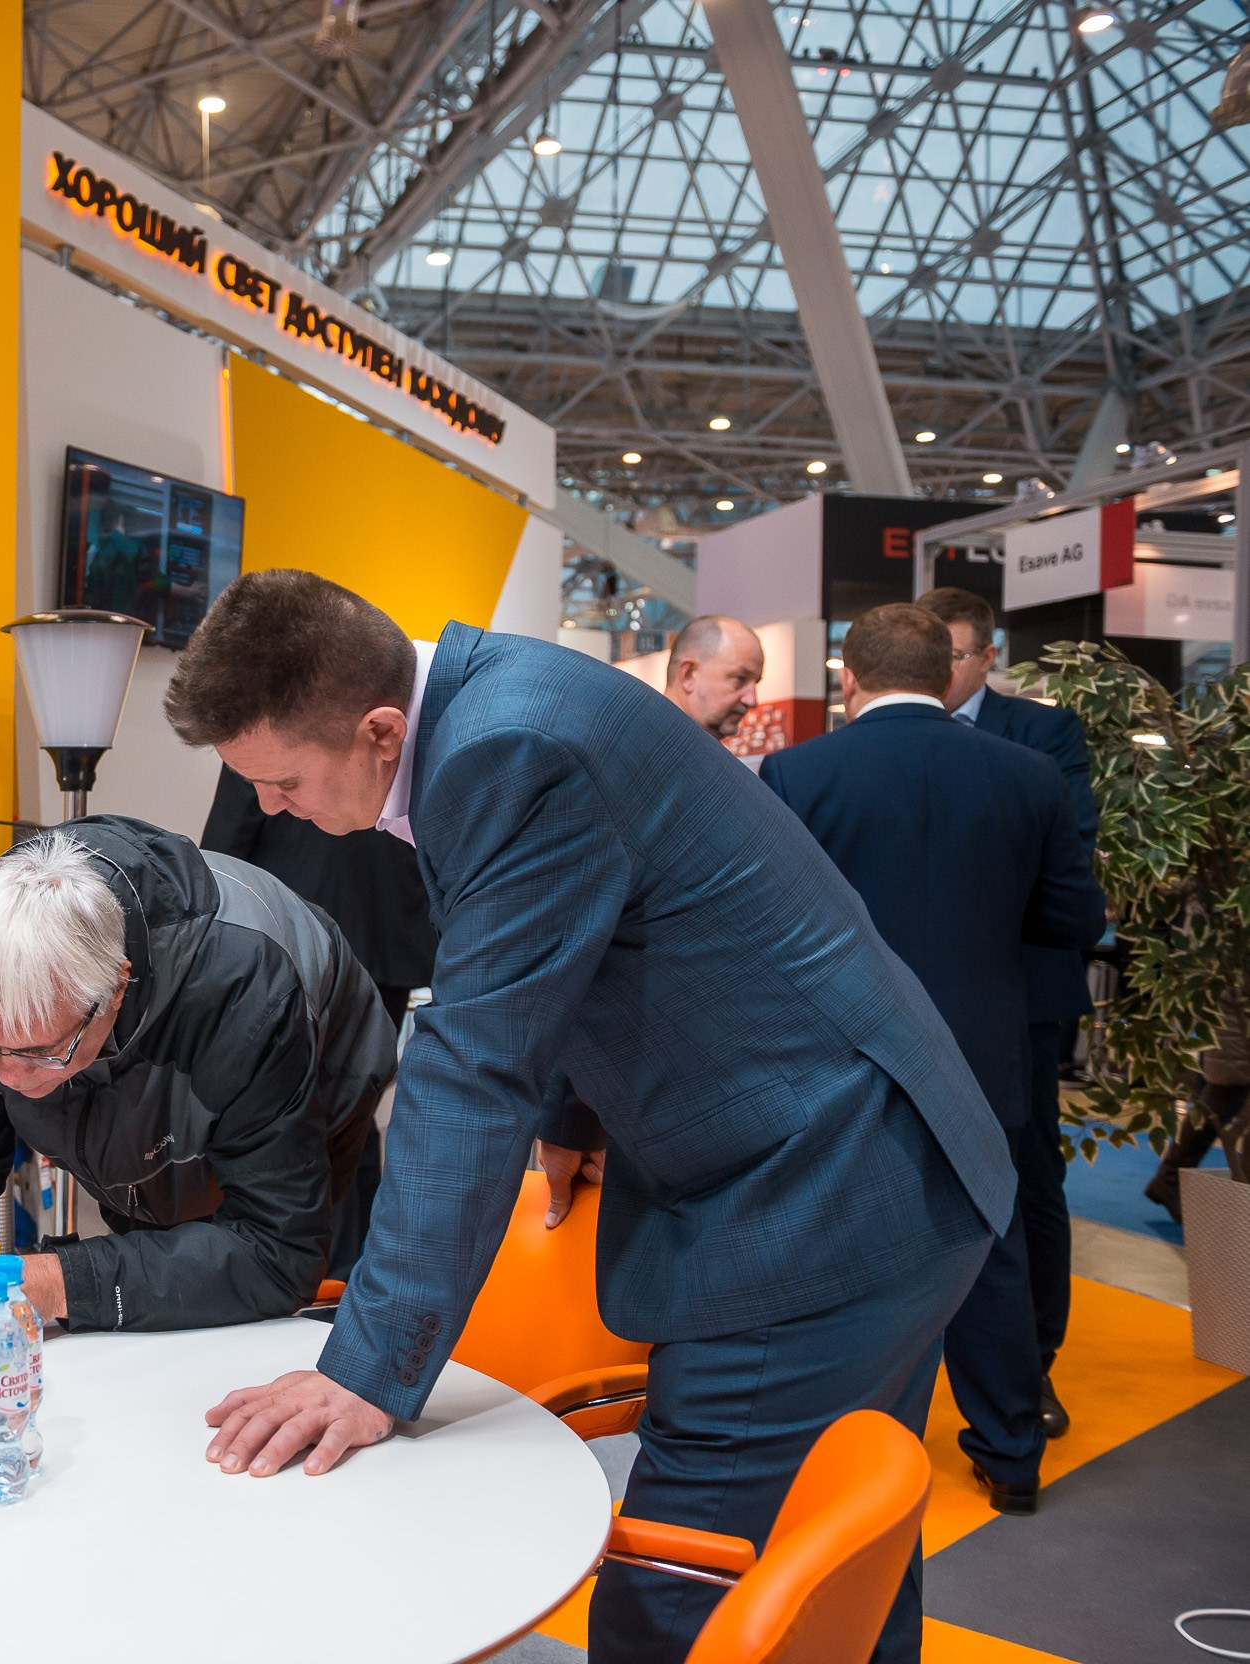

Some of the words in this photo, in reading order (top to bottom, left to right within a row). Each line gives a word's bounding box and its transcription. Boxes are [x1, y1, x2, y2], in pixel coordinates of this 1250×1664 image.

[51, 150, 208, 274] ХОРОШИЙ
[217, 253, 282, 314] СВЕТ
[283, 290, 405, 388] ДОСТУПЕН
[1018, 552, 1059, 576] Esave
[1062, 542, 1084, 563] AG
